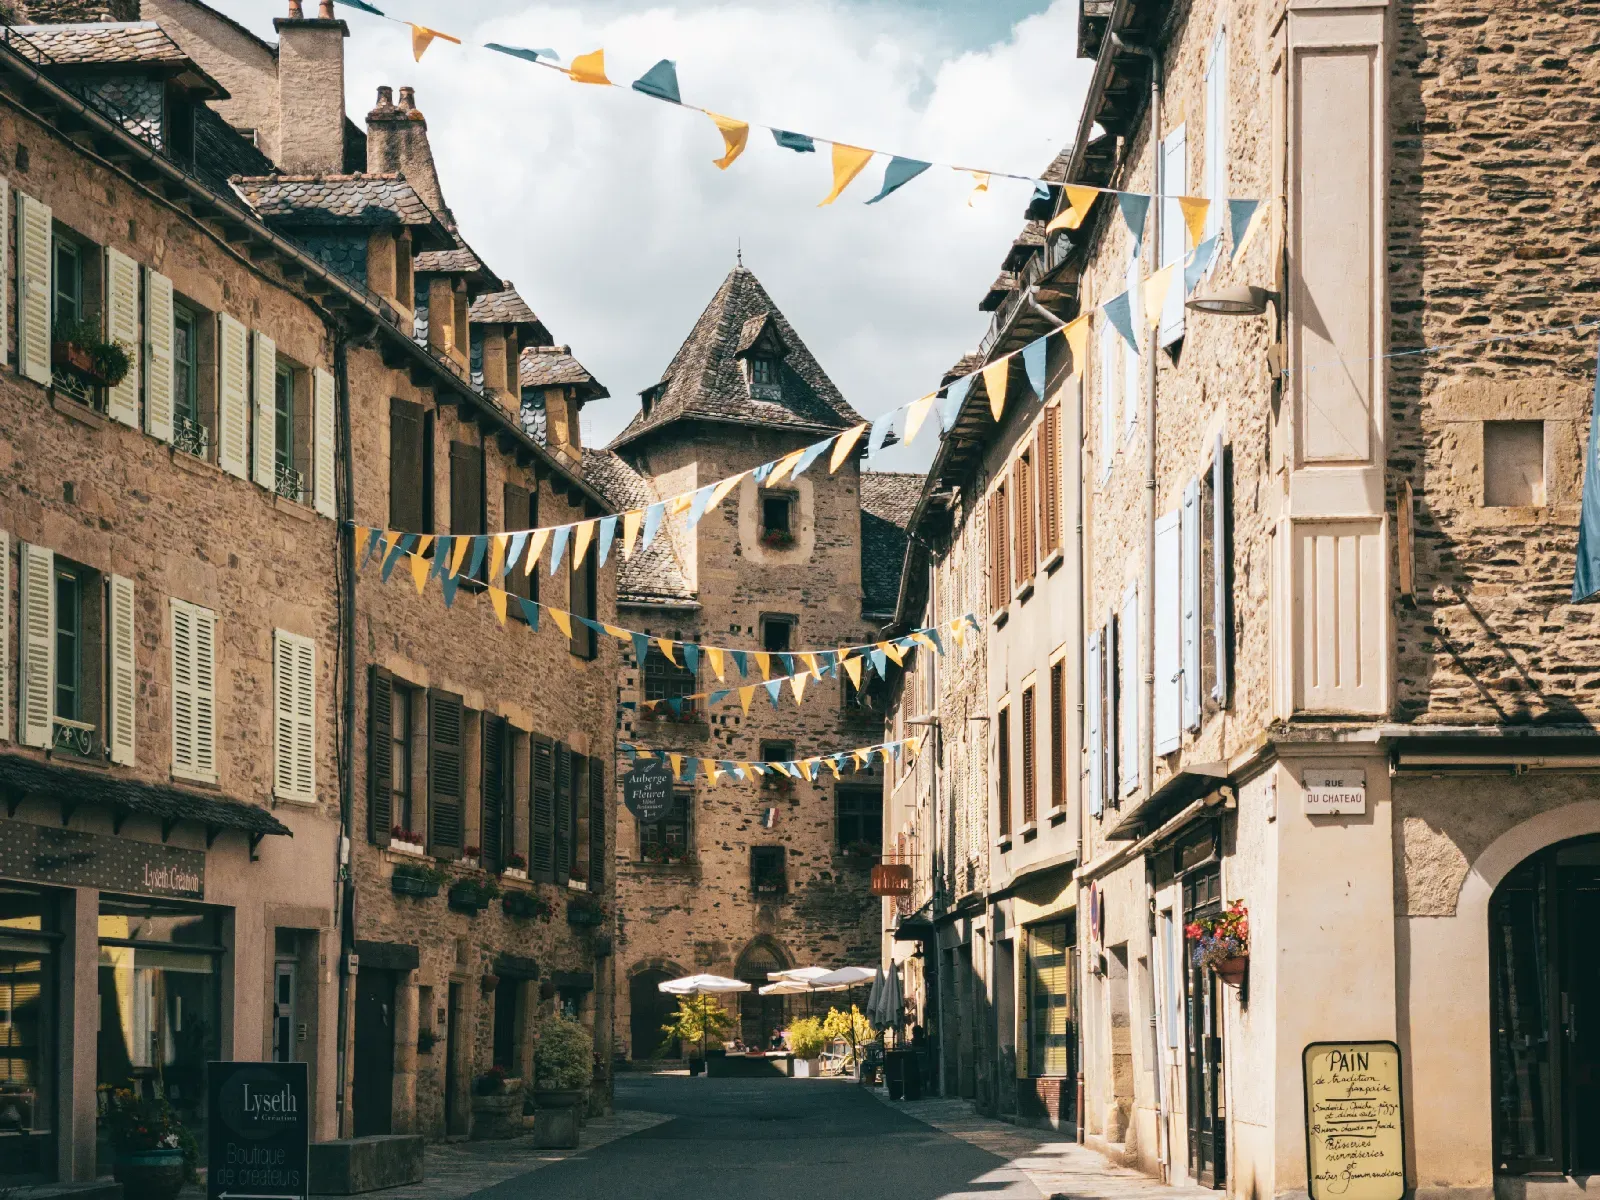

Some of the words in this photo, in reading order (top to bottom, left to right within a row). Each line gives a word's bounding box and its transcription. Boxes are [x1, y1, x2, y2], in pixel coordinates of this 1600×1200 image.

[629, 774, 668, 785] Auberge
[632, 790, 665, 799] Fleuret
[1308, 794, 1318, 803] DU
[1323, 794, 1362, 803] CHATEAU
[145, 864, 168, 892] Lyseth
[1328, 1073, 1380, 1084] tradition
[243, 1083, 298, 1119] Lyseth
[227, 1142, 285, 1166] Boutique
[1347, 1161, 1357, 1170] et
[217, 1164, 234, 1185] de
